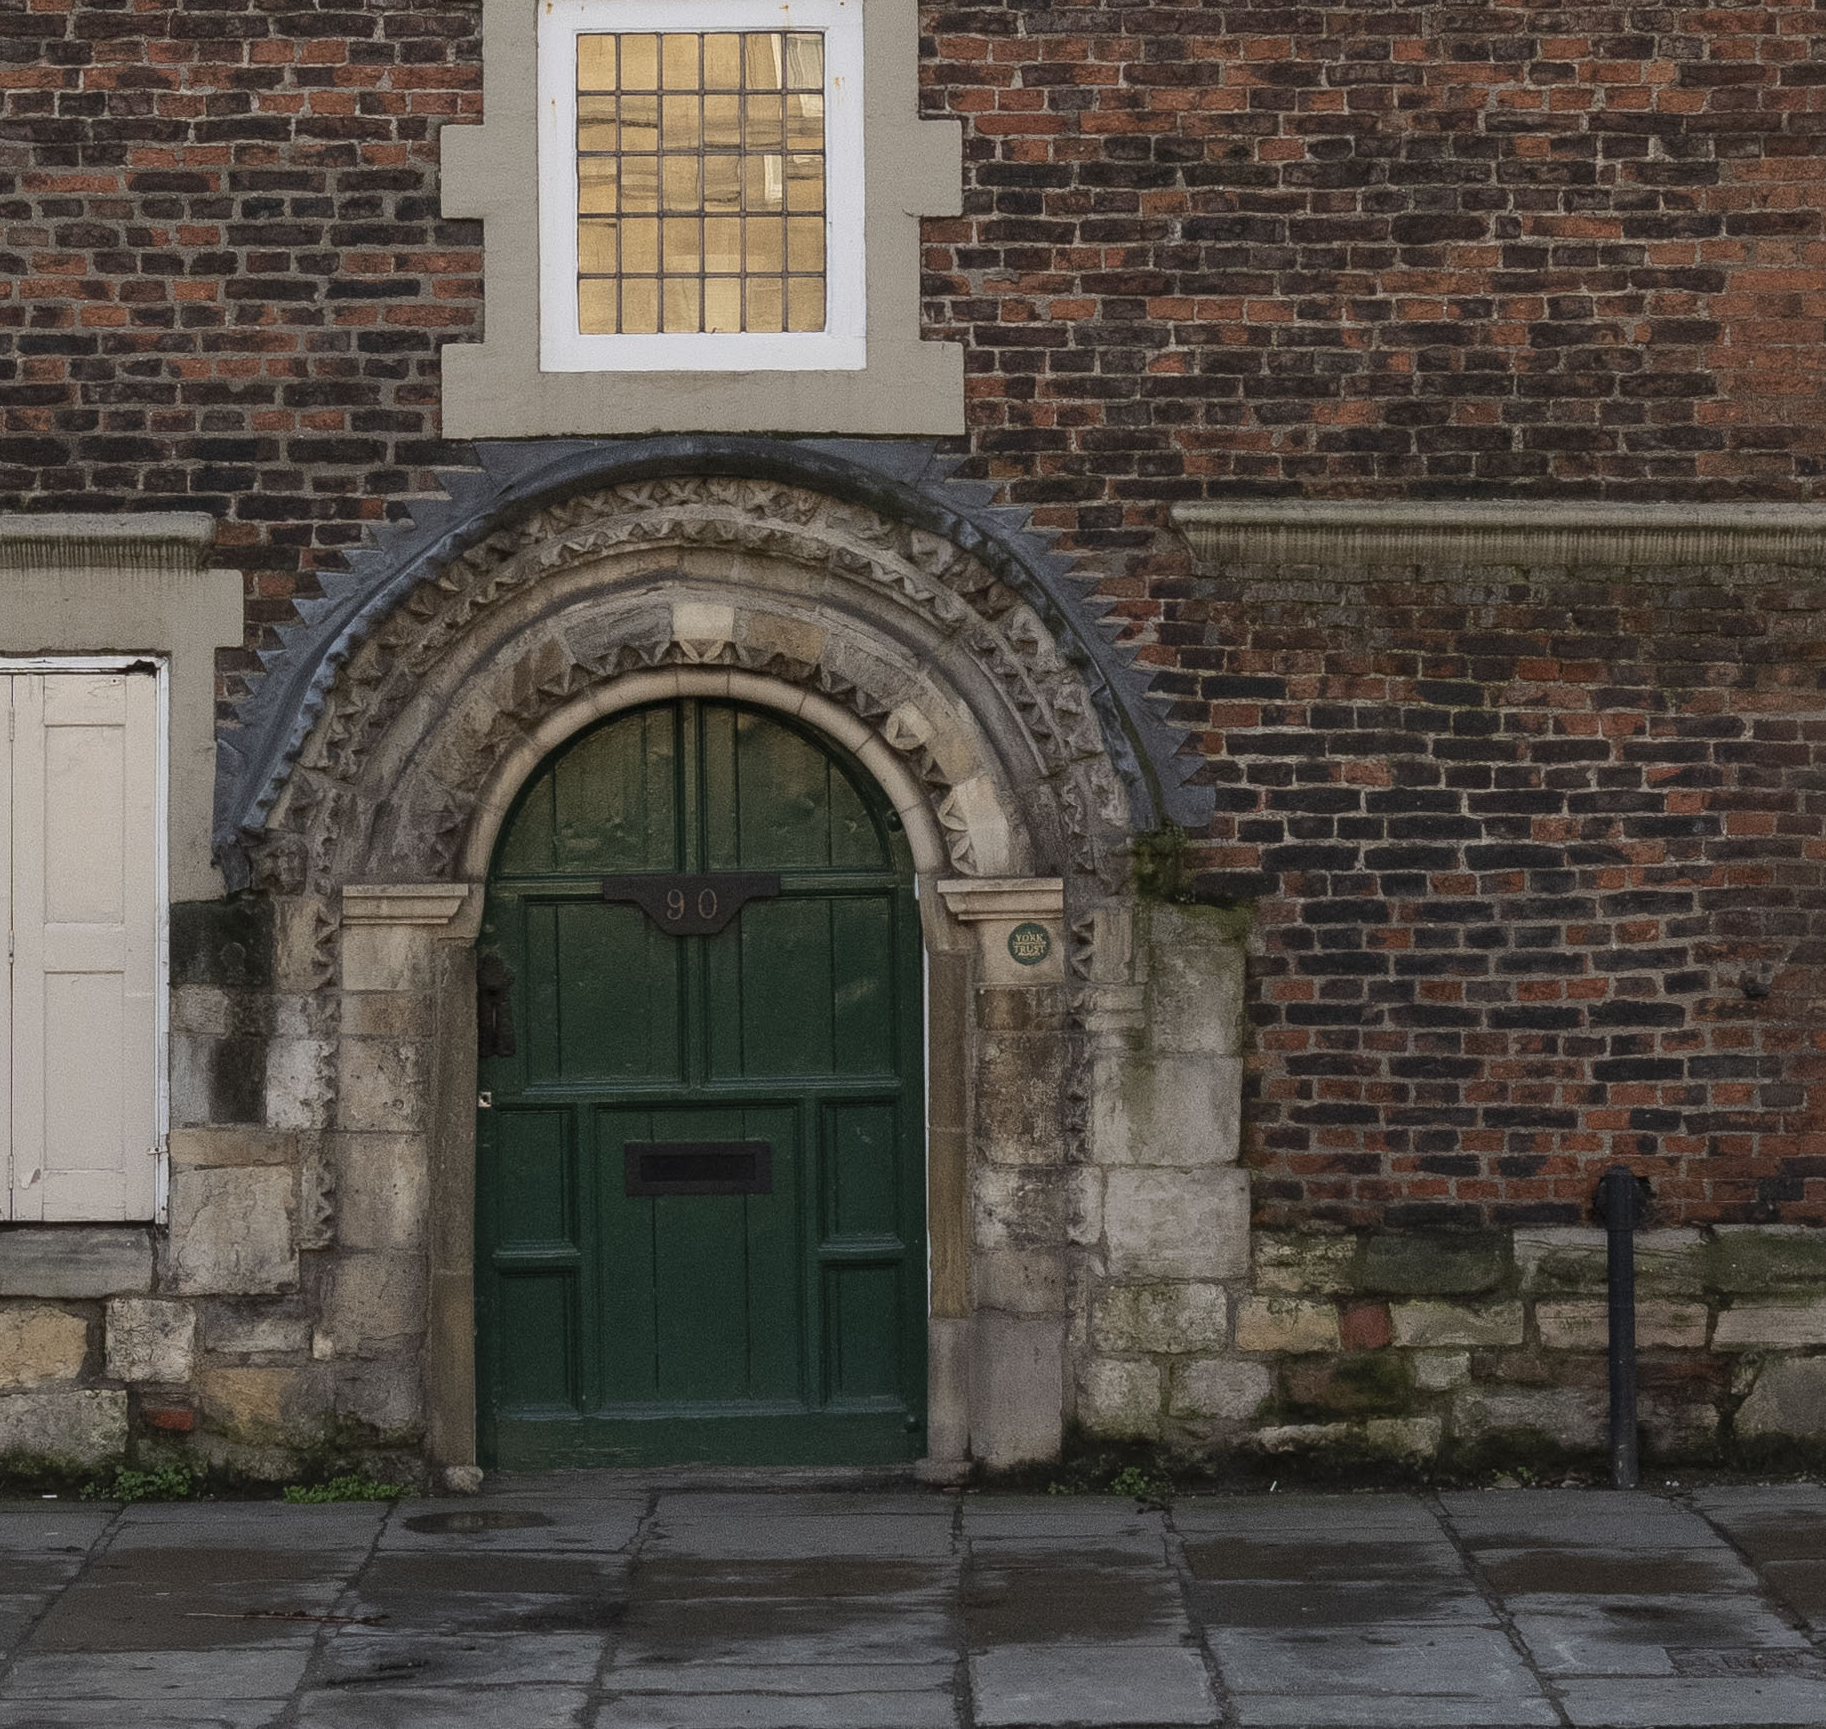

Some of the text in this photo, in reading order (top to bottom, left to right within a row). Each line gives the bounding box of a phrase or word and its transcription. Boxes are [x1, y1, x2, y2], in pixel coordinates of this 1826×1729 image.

[667, 888, 717, 920] 90
[1015, 932, 1044, 942] YORK
[1014, 945, 1045, 954] TRUST
